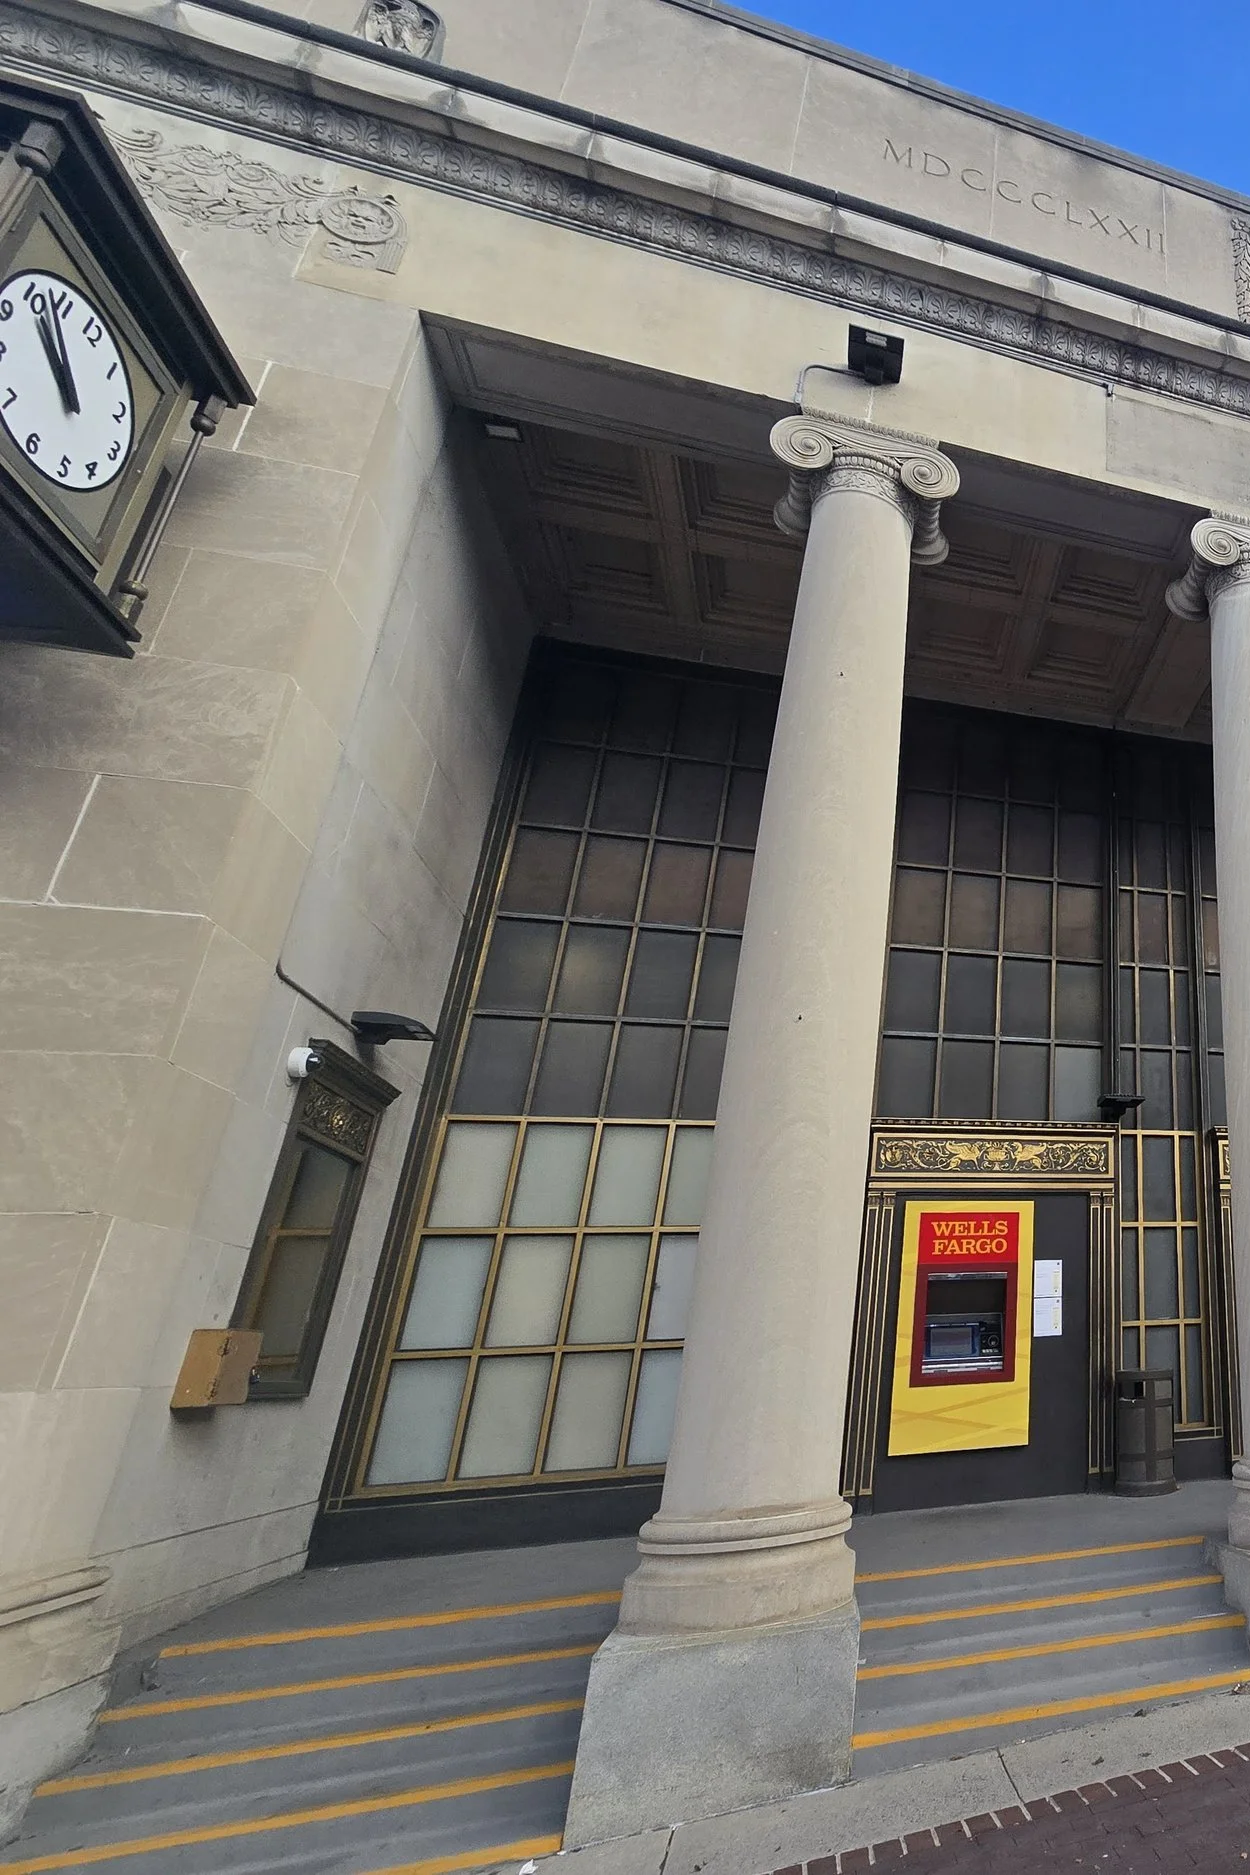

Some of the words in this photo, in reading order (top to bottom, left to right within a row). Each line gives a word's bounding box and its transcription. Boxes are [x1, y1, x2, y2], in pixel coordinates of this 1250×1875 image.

[883, 138, 1165, 254] MDCCCLXXII
[23, 281, 47, 315] 10
[82, 316, 102, 348] 12
[106, 362, 118, 380] 1
[2, 387, 18, 410] 7
[112, 402, 126, 423] 2
[25, 433, 41, 454] 6
[107, 440, 121, 461] 3
[57, 455, 72, 478] 5
[85, 461, 98, 480] 4
[931, 1220, 1009, 1236] WELLS
[932, 1238, 1008, 1255] FARGO
